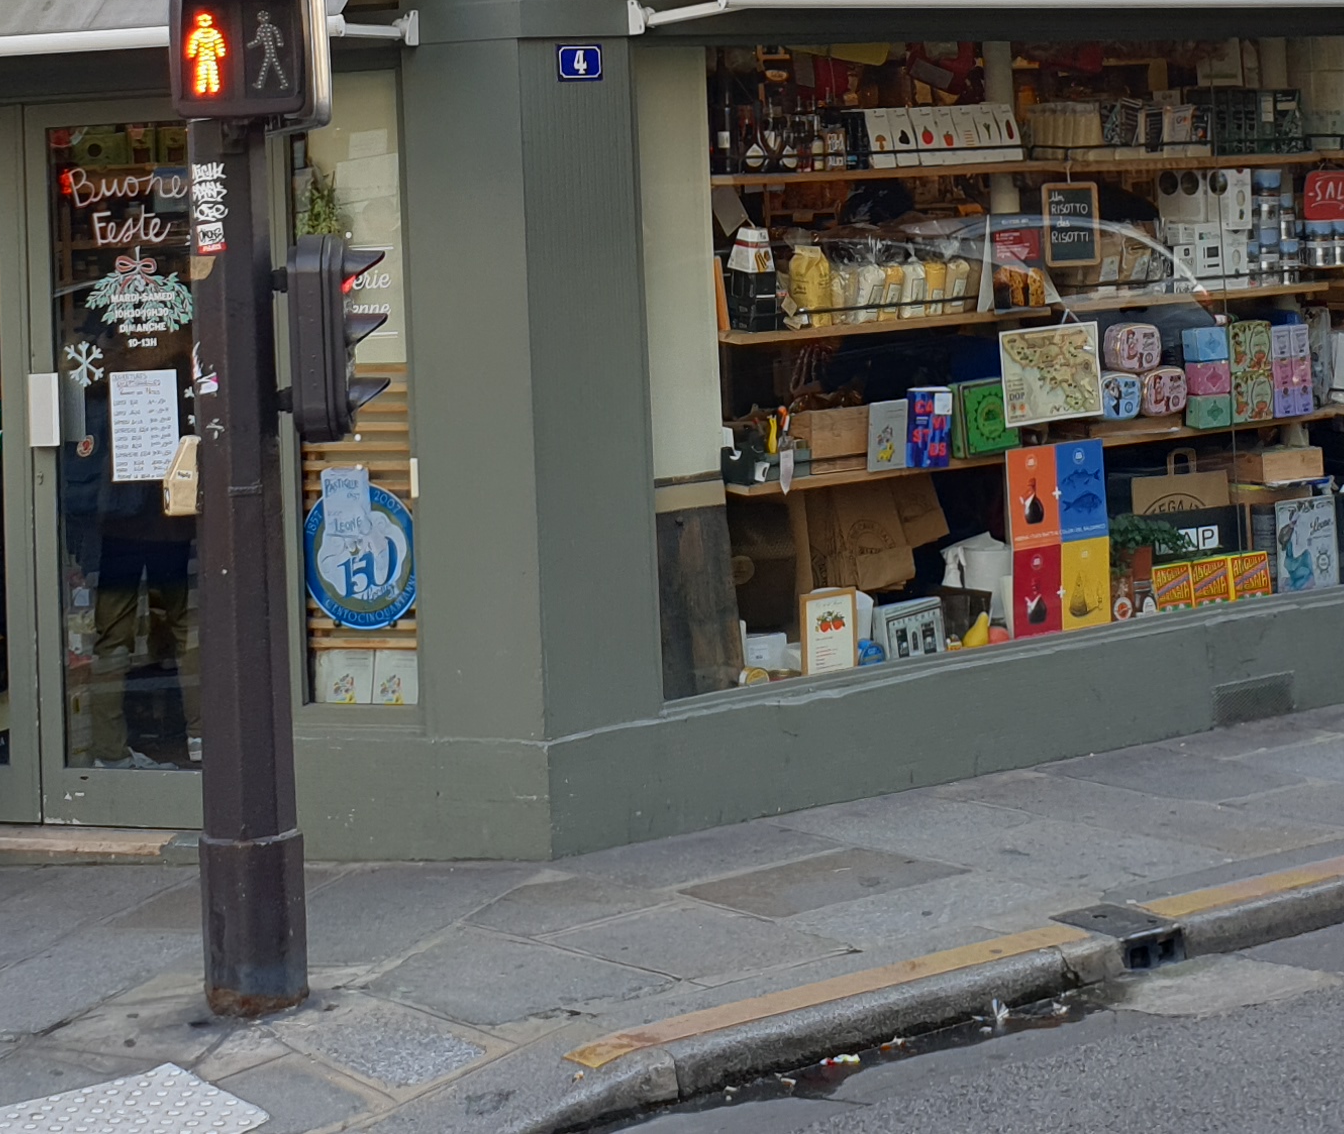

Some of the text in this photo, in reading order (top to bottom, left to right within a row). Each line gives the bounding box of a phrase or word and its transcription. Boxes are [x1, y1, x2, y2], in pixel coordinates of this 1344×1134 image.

[573, 50, 587, 74] 4
[68, 167, 188, 207] Buone
[1051, 203, 1089, 215] RISOTTO
[92, 204, 171, 246] Feste
[1051, 231, 1089, 243] RISOTTI
[352, 270, 392, 290] erie
[110, 293, 176, 303] MARDI-SAMEDI
[119, 321, 167, 333] DIMANCHE
[127, 337, 158, 348] 10-13H
[373, 489, 402, 514] 2007
[306, 509, 323, 536] 1857
